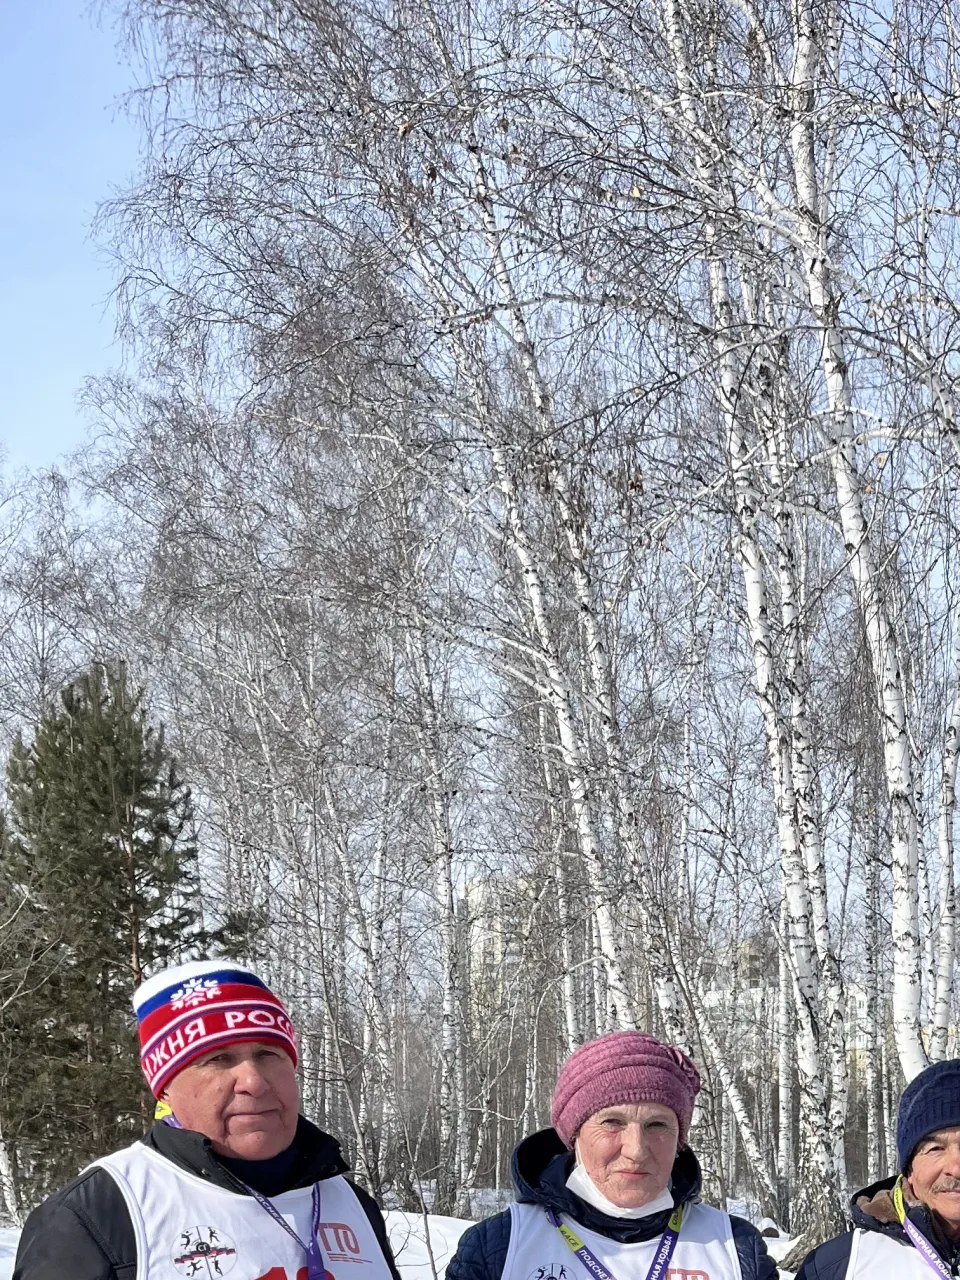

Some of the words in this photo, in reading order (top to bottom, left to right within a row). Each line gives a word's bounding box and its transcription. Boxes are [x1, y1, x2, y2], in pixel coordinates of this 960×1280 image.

[560, 1229, 580, 1247] RACE
[658, 1235, 674, 1267] ХОДЬБА
[906, 1223, 938, 1260] СЕВЕРНАЯ
